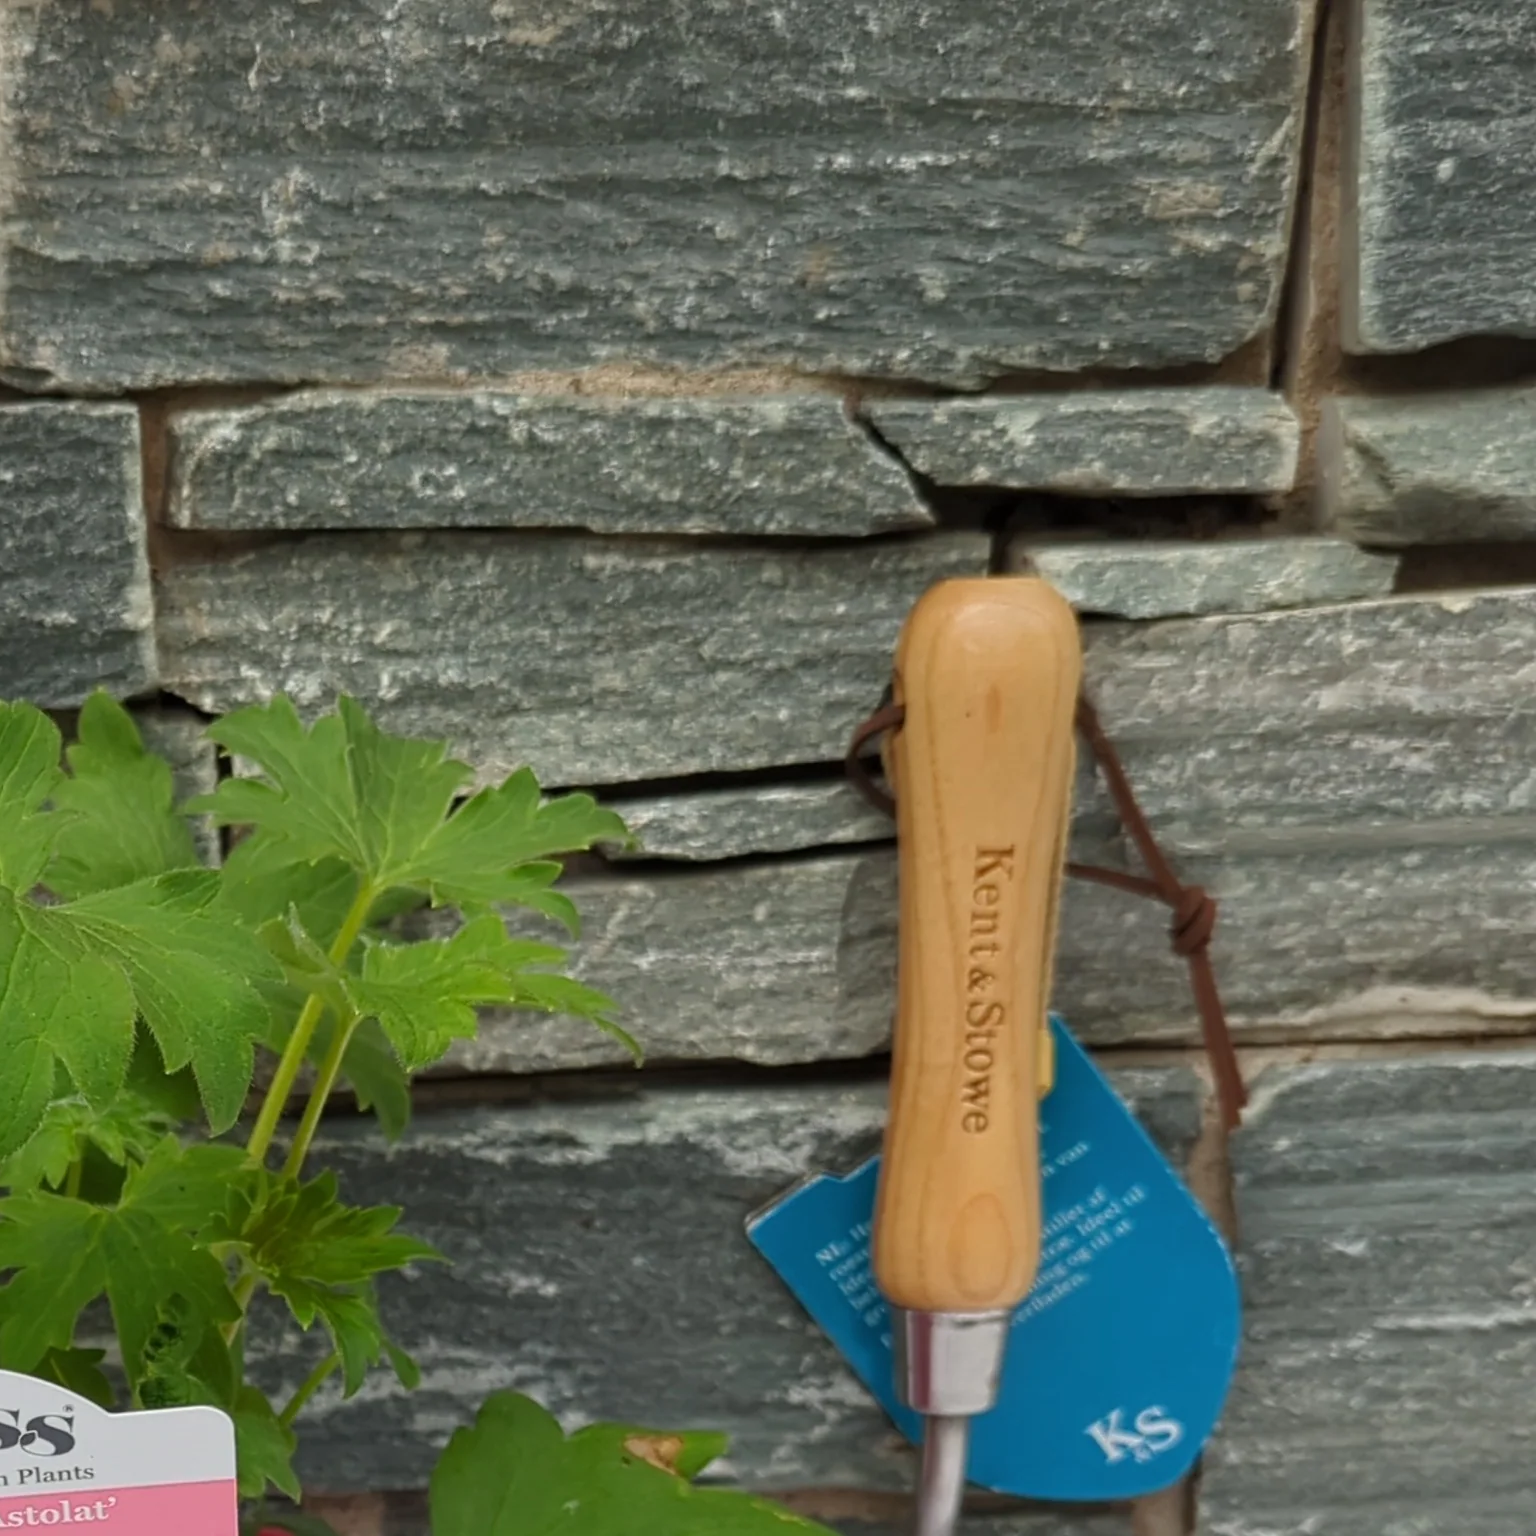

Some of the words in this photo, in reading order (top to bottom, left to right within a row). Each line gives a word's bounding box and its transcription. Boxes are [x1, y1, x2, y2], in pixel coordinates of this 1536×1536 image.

[969, 844, 1015, 957] Kent
[967, 968, 995, 993] &
[961, 1001, 1005, 1134] Stowe
[16, 1465, 95, 1486] Plants
